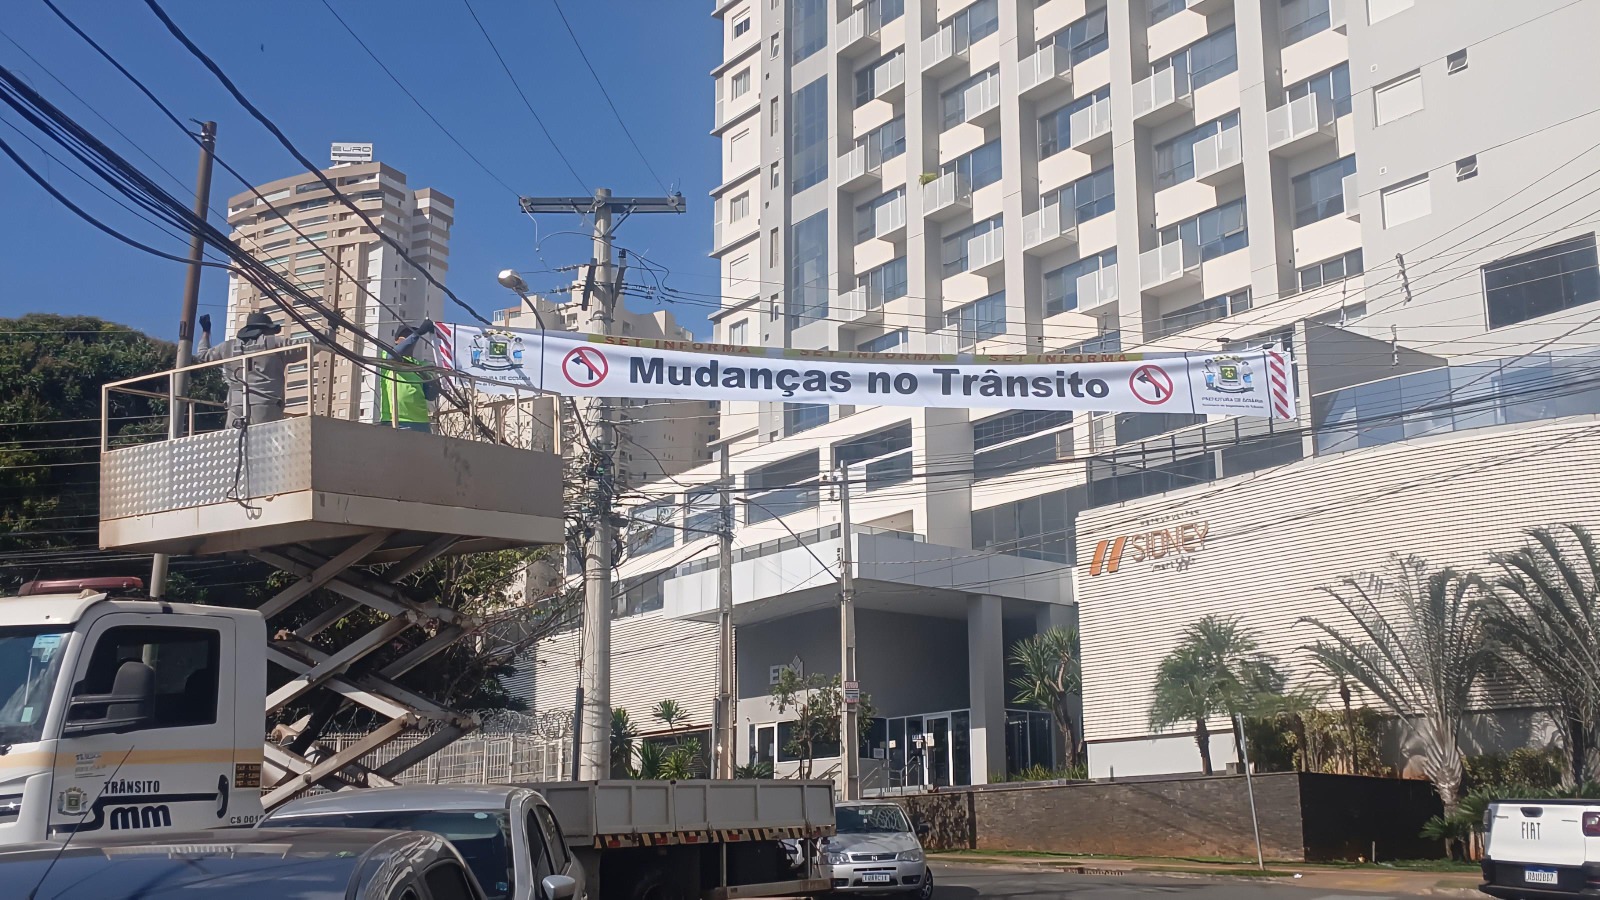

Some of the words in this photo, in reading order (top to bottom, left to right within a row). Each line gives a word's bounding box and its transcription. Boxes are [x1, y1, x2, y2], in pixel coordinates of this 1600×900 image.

[605, 336, 645, 347] SET
[655, 339, 750, 353] INFORMA
[989, 354, 1025, 362] SET
[1037, 354, 1126, 363] INFORMA
[629, 356, 852, 397] Mudanças
[868, 371, 918, 394] no
[933, 368, 1110, 398] Trânsito
[1132, 520, 1209, 562] SIDNEY
[104, 778, 160, 794] TRÂNSITO
[1521, 822, 1541, 840] FIAT
